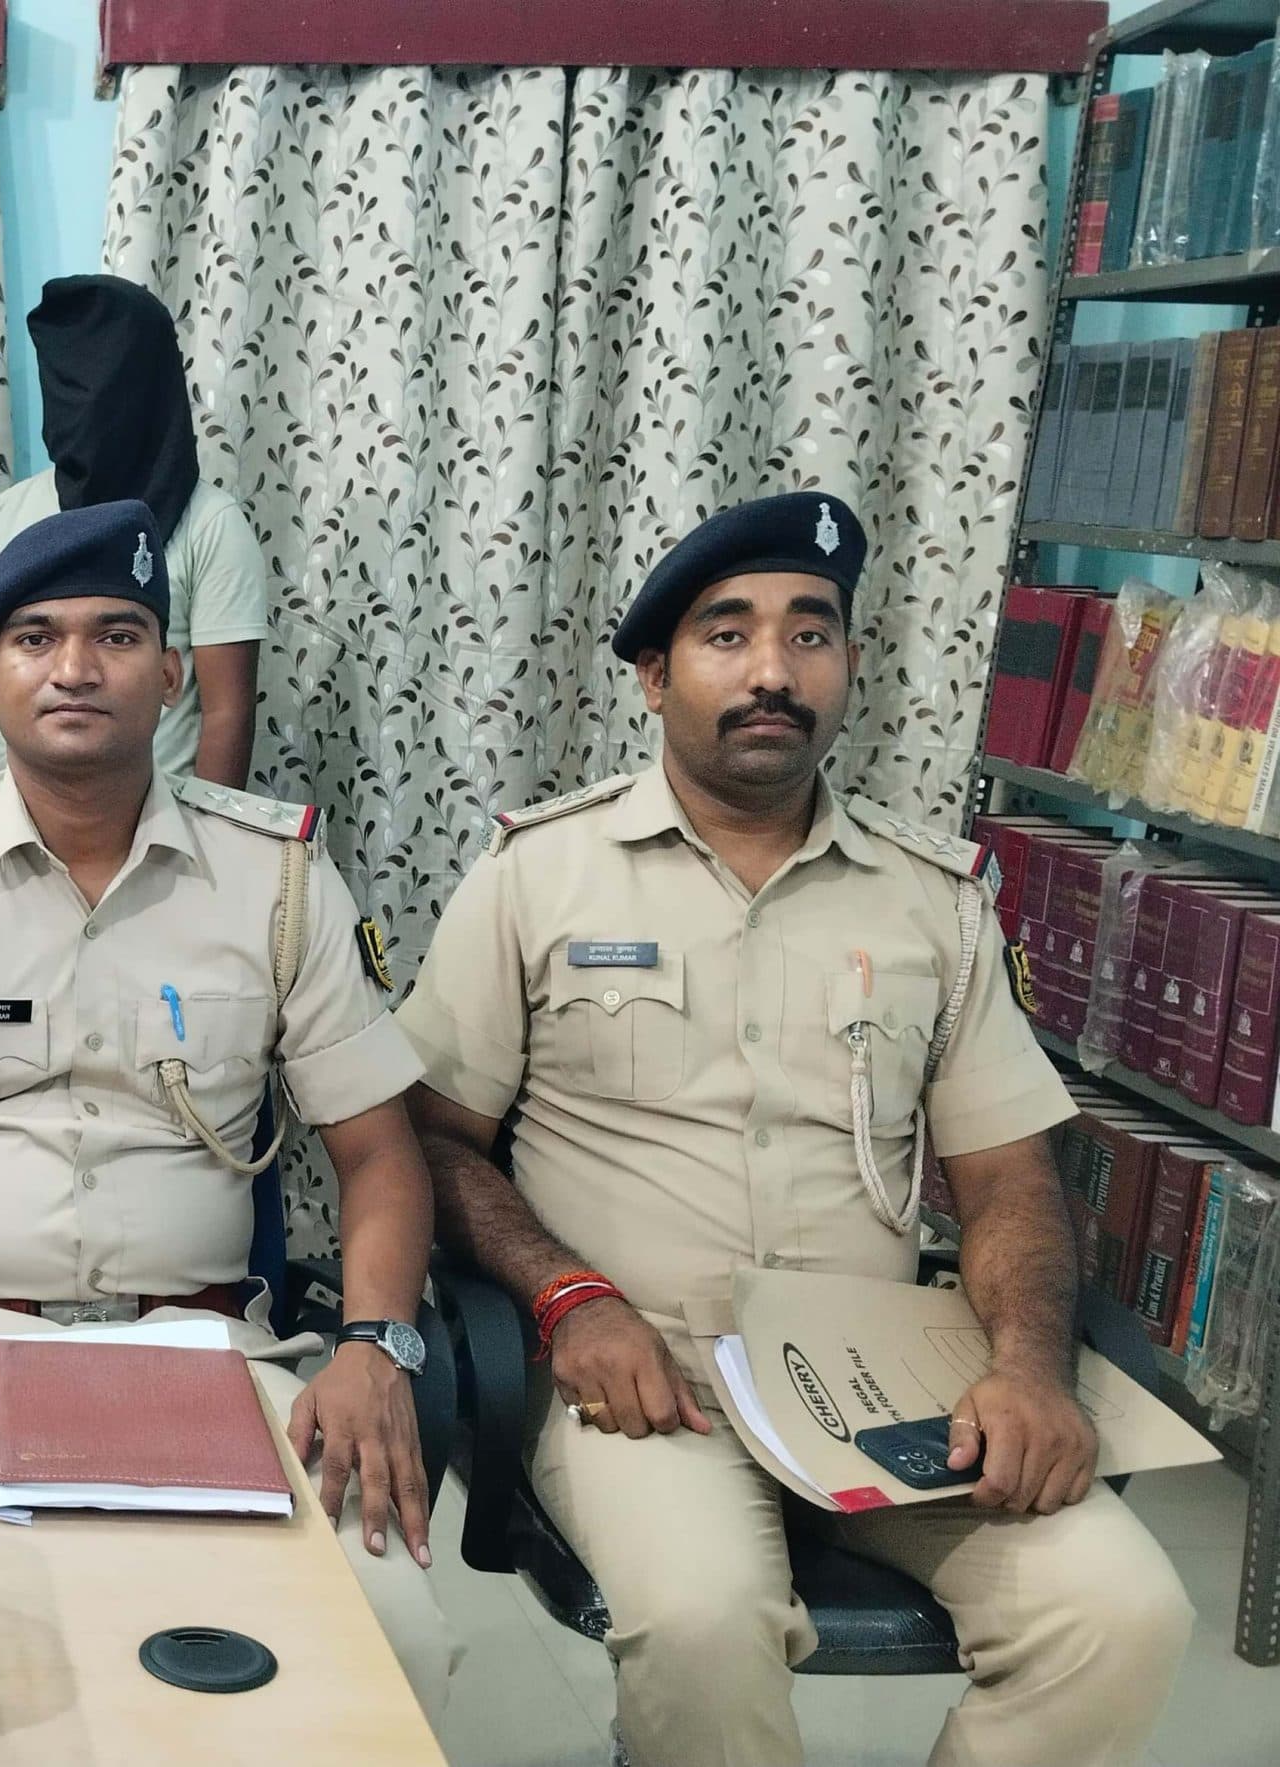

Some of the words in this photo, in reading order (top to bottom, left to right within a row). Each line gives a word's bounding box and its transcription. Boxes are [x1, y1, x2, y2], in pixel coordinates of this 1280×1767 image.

[846, 1347, 866, 1369] FILE
[791, 1360, 838, 1429] CHERRY
[848, 1377, 879, 1414] REGAL
[860, 1371, 893, 1408] FOLDER
